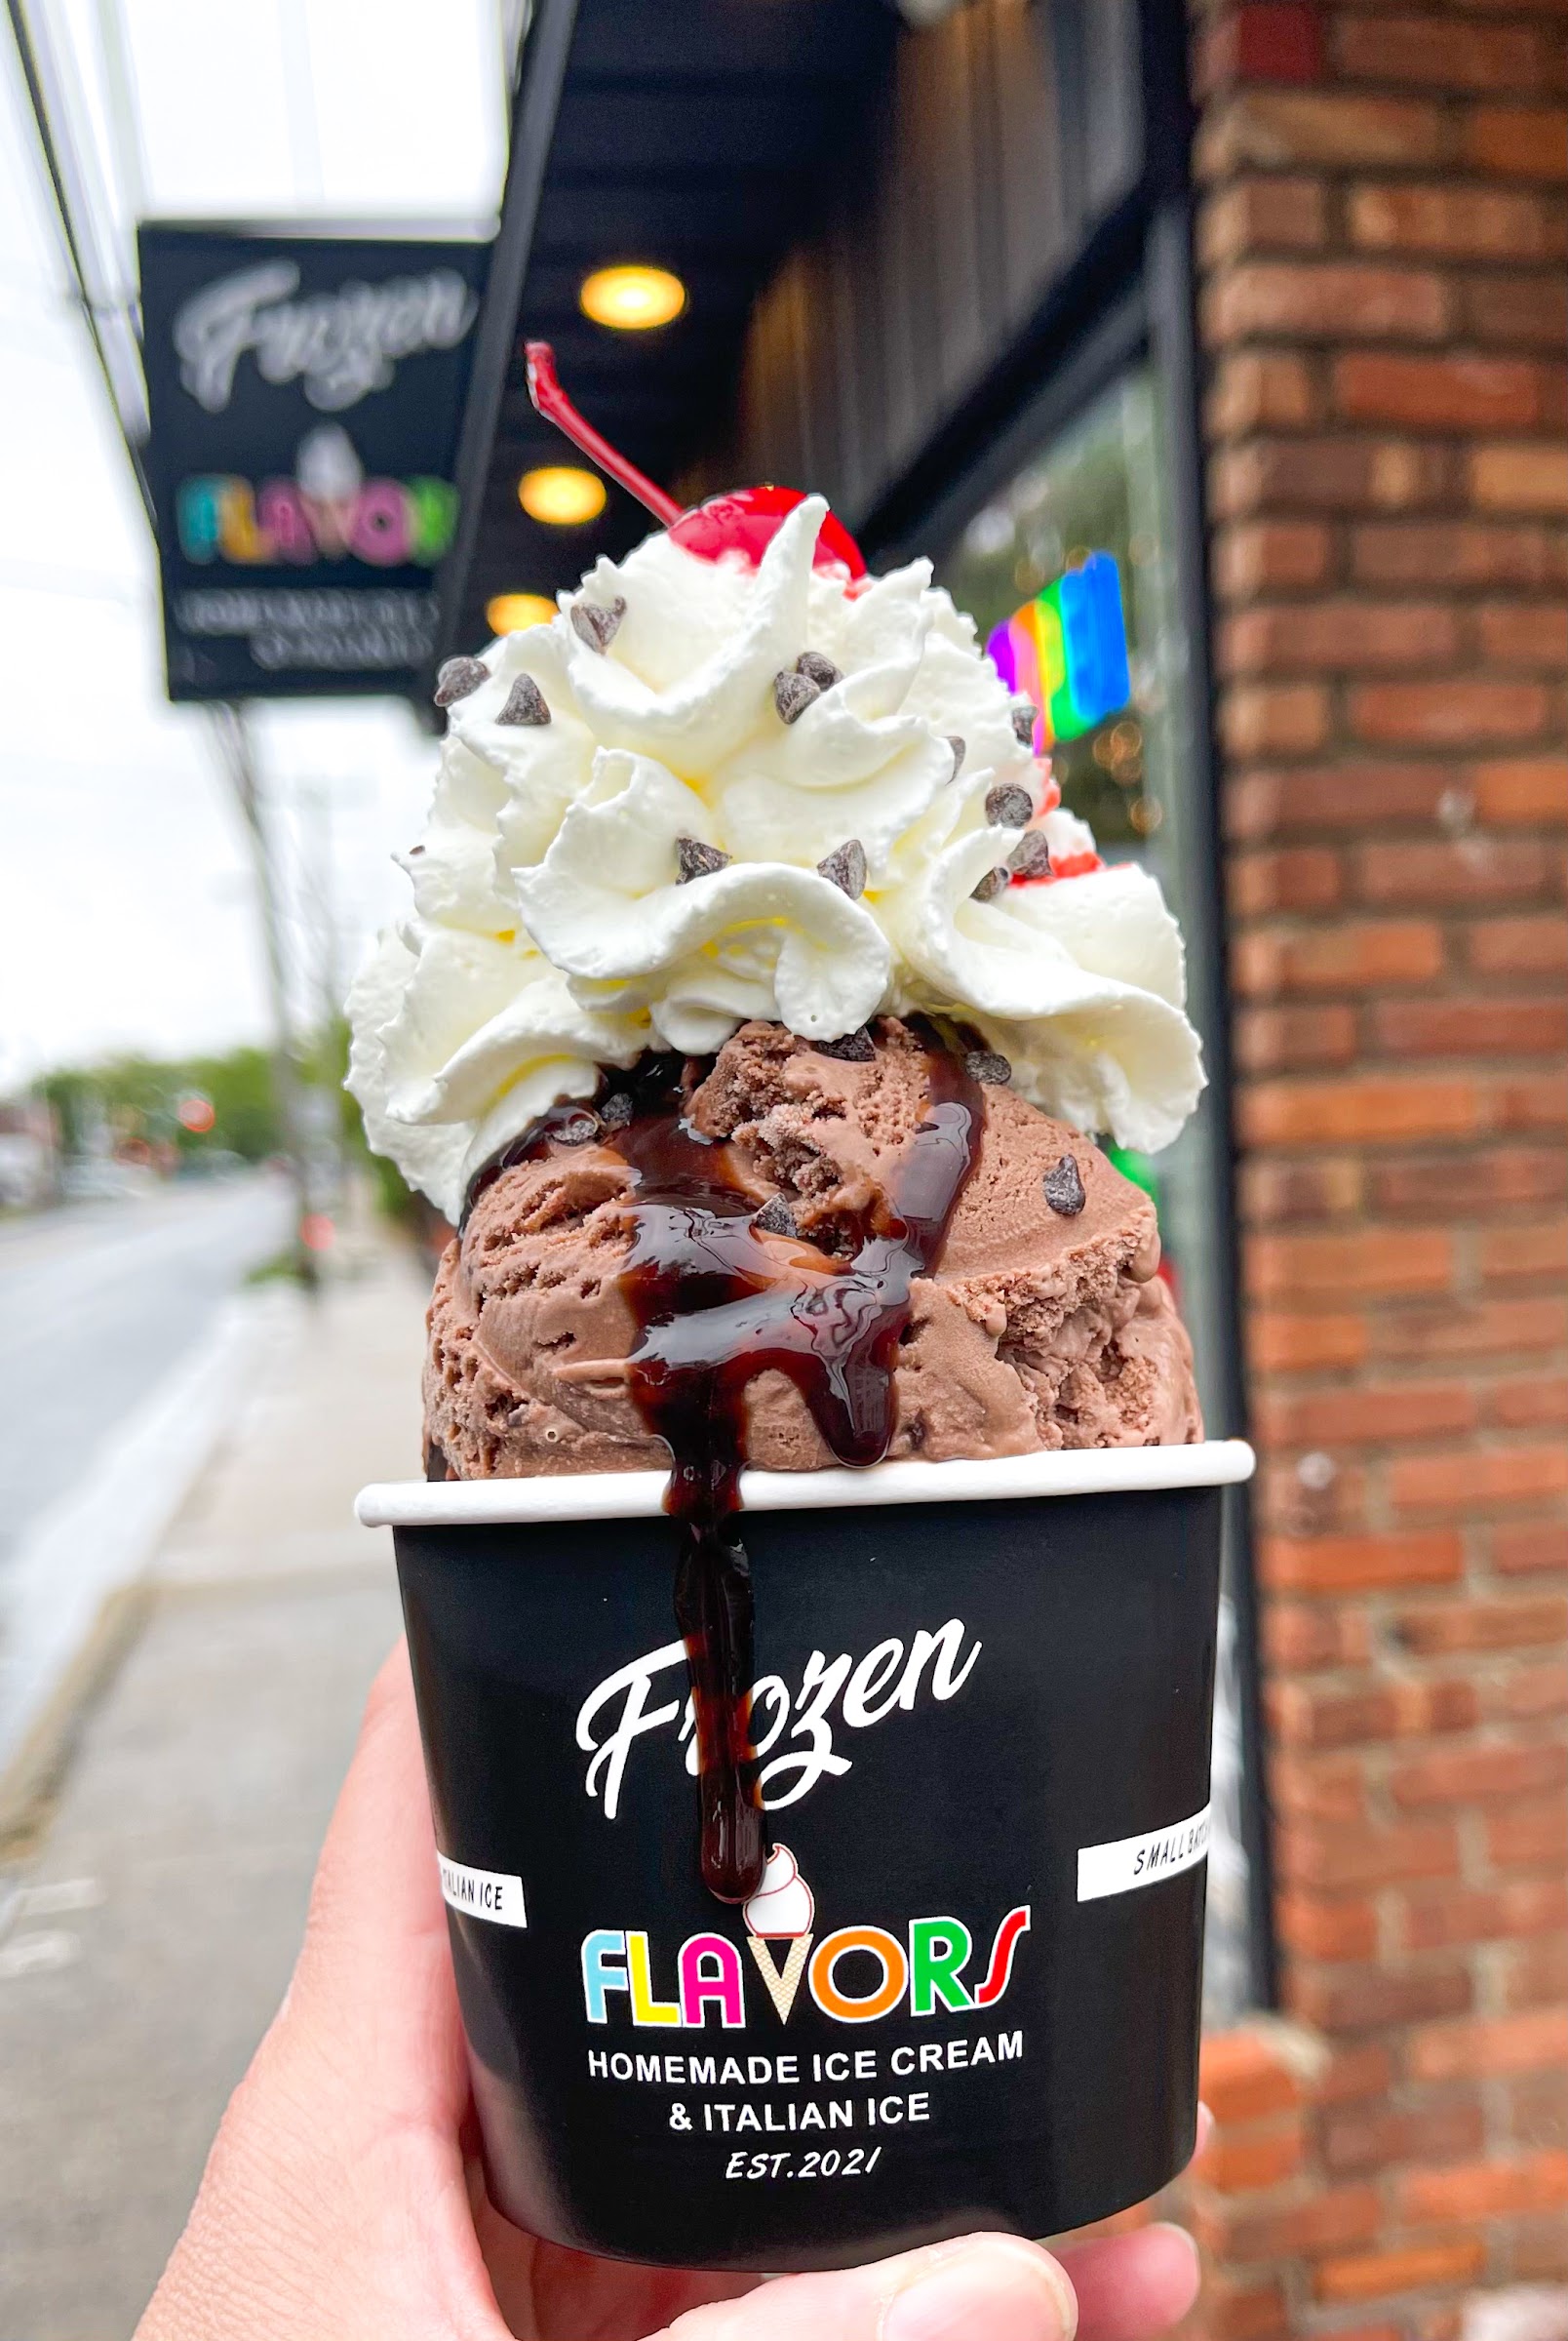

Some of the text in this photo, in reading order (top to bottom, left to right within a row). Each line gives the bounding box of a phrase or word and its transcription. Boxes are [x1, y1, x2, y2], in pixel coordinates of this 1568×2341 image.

[1134, 1834, 1184, 1875] SMALL
[443, 1869, 502, 1910] TALIAN ICE
[580, 1904, 1032, 2029] FLAVORS
[588, 2029, 1024, 2084] HOMEMADE ICE CREAM
[669, 2091, 930, 2132] & ITALIAN ICE
